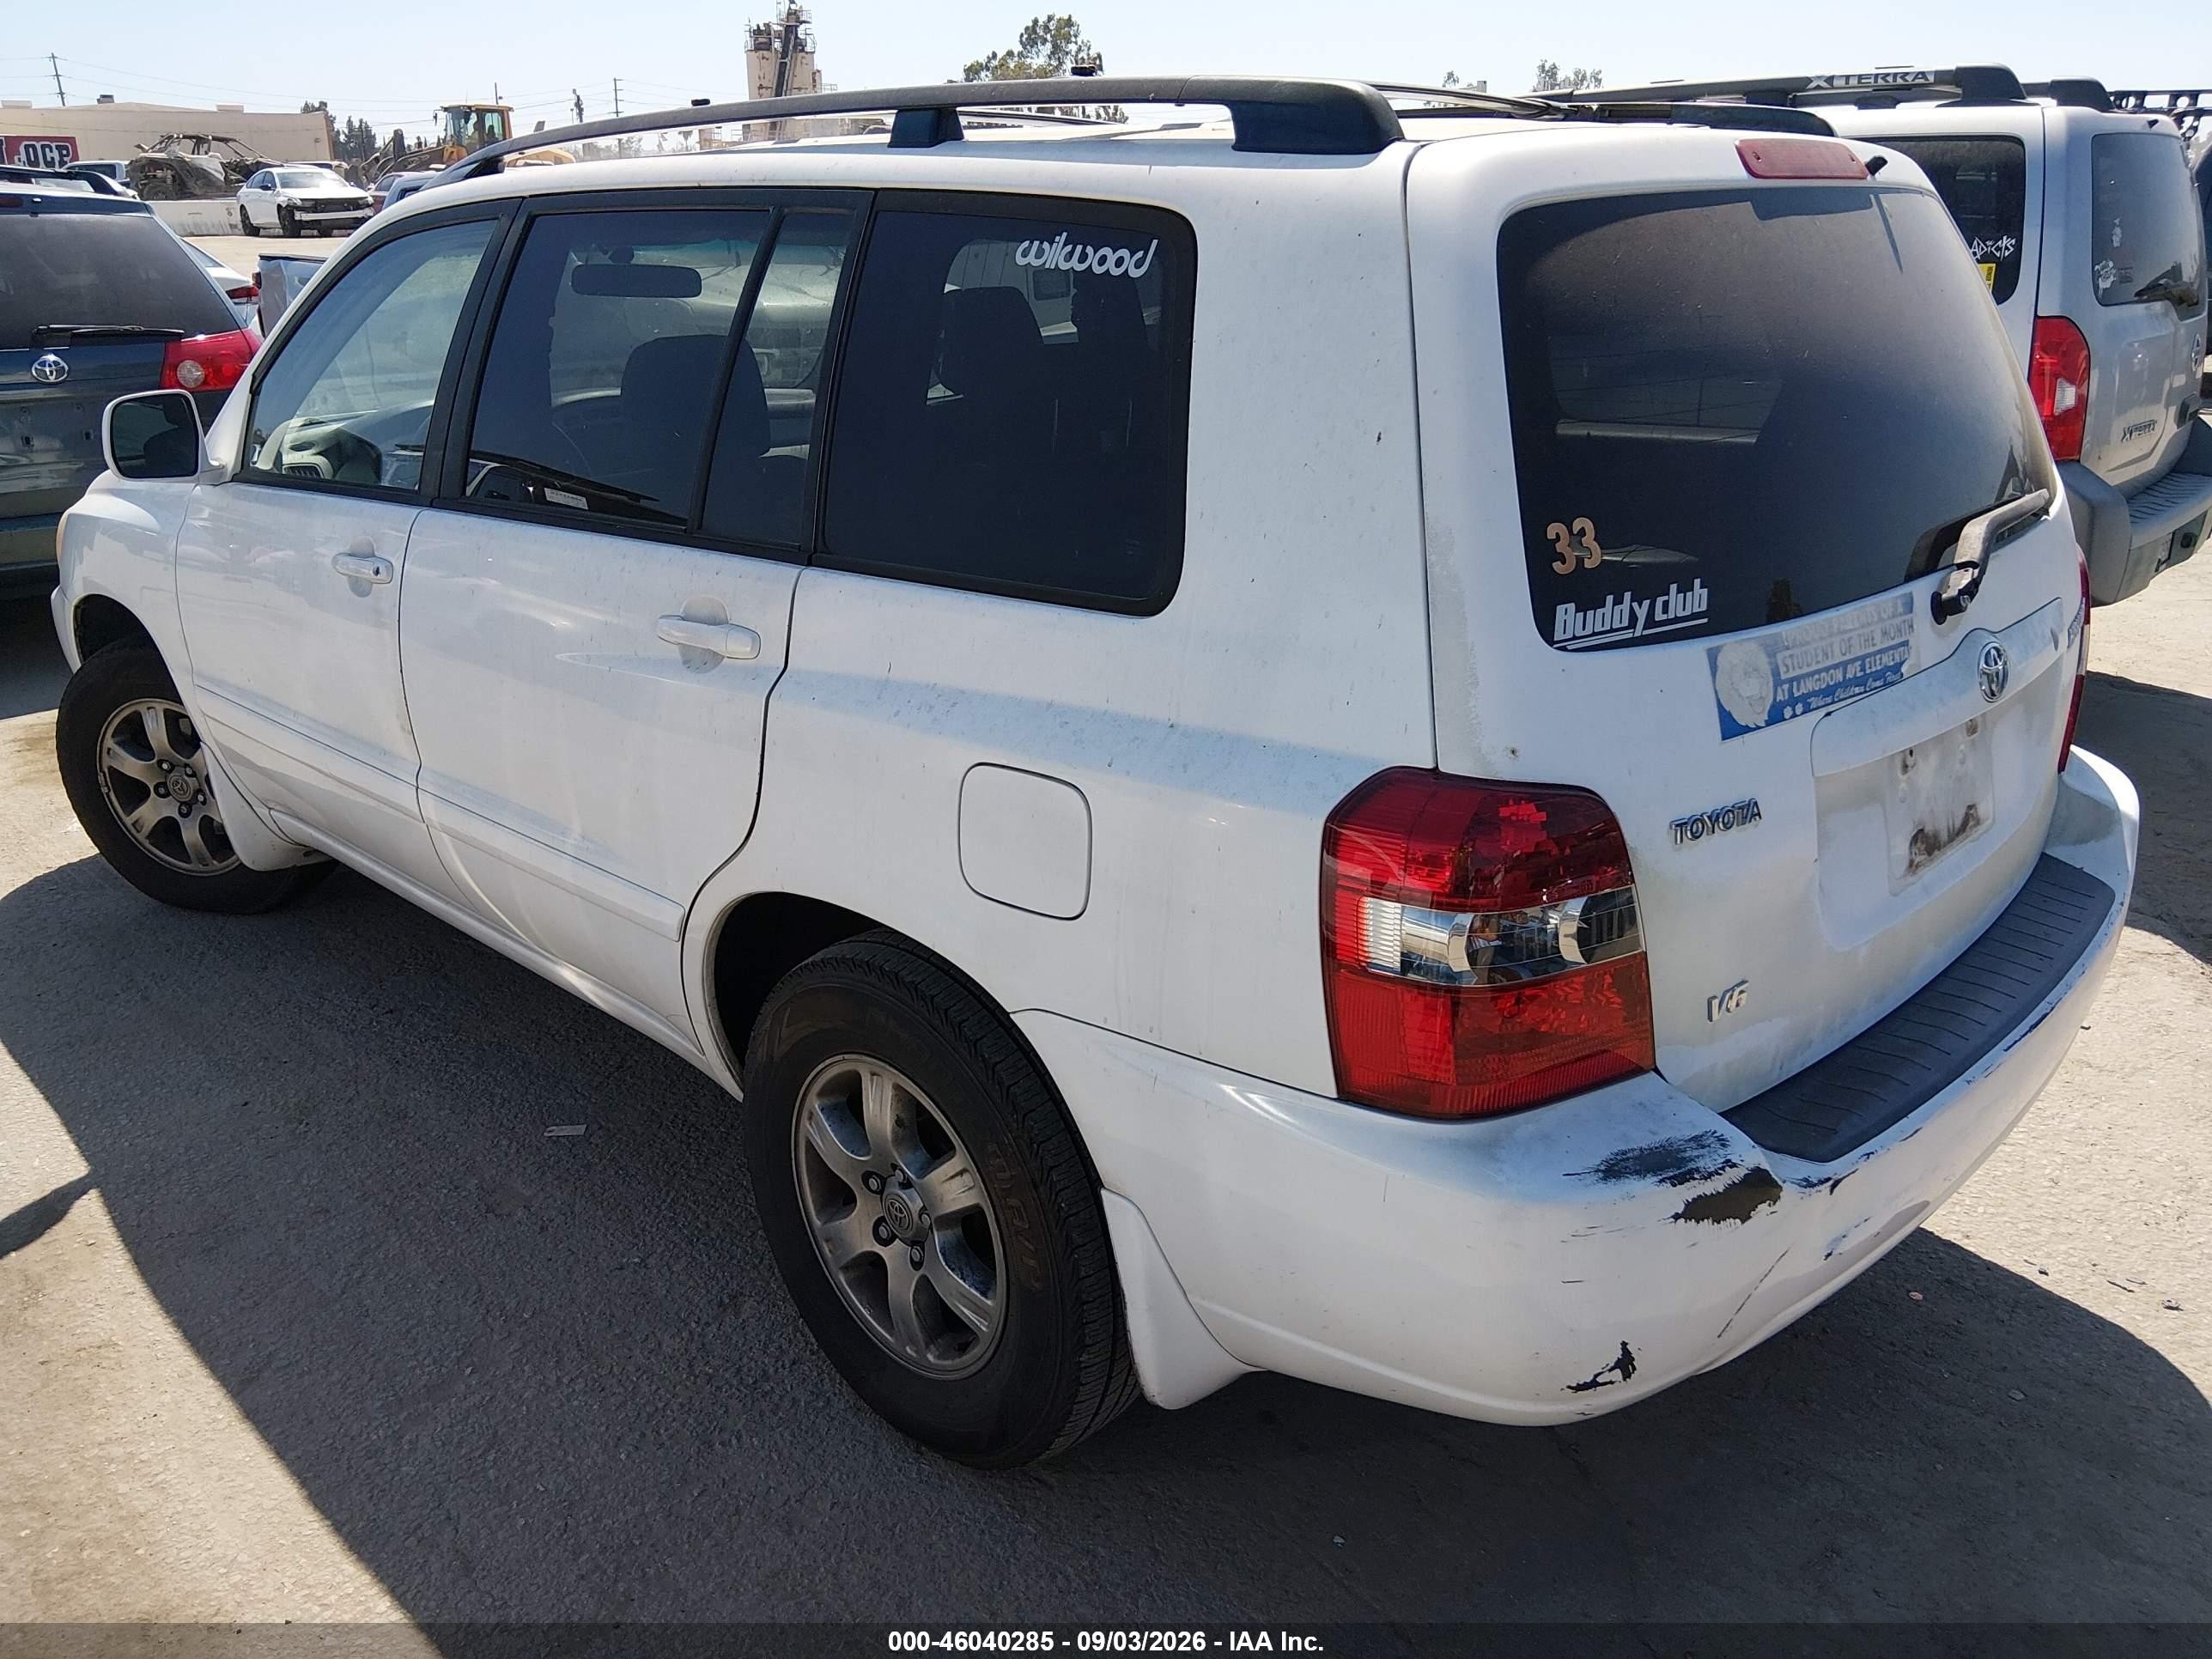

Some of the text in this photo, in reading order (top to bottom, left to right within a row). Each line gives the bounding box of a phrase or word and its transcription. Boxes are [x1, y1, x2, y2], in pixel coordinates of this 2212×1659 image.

[1806, 70, 1935, 89] XTERRA
[1015, 232, 1158, 278] wilwood
[1547, 517, 1601, 574] 33
[1654, 578, 1708, 621] club
[1781, 617, 1915, 675] STUDENT OF THE MONTH
[1776, 684, 1790, 702] AT
[1793, 667, 1844, 697] LANGDON
[1669, 798, 1762, 845] TOYOTA
[1707, 980, 1749, 1022] V6
